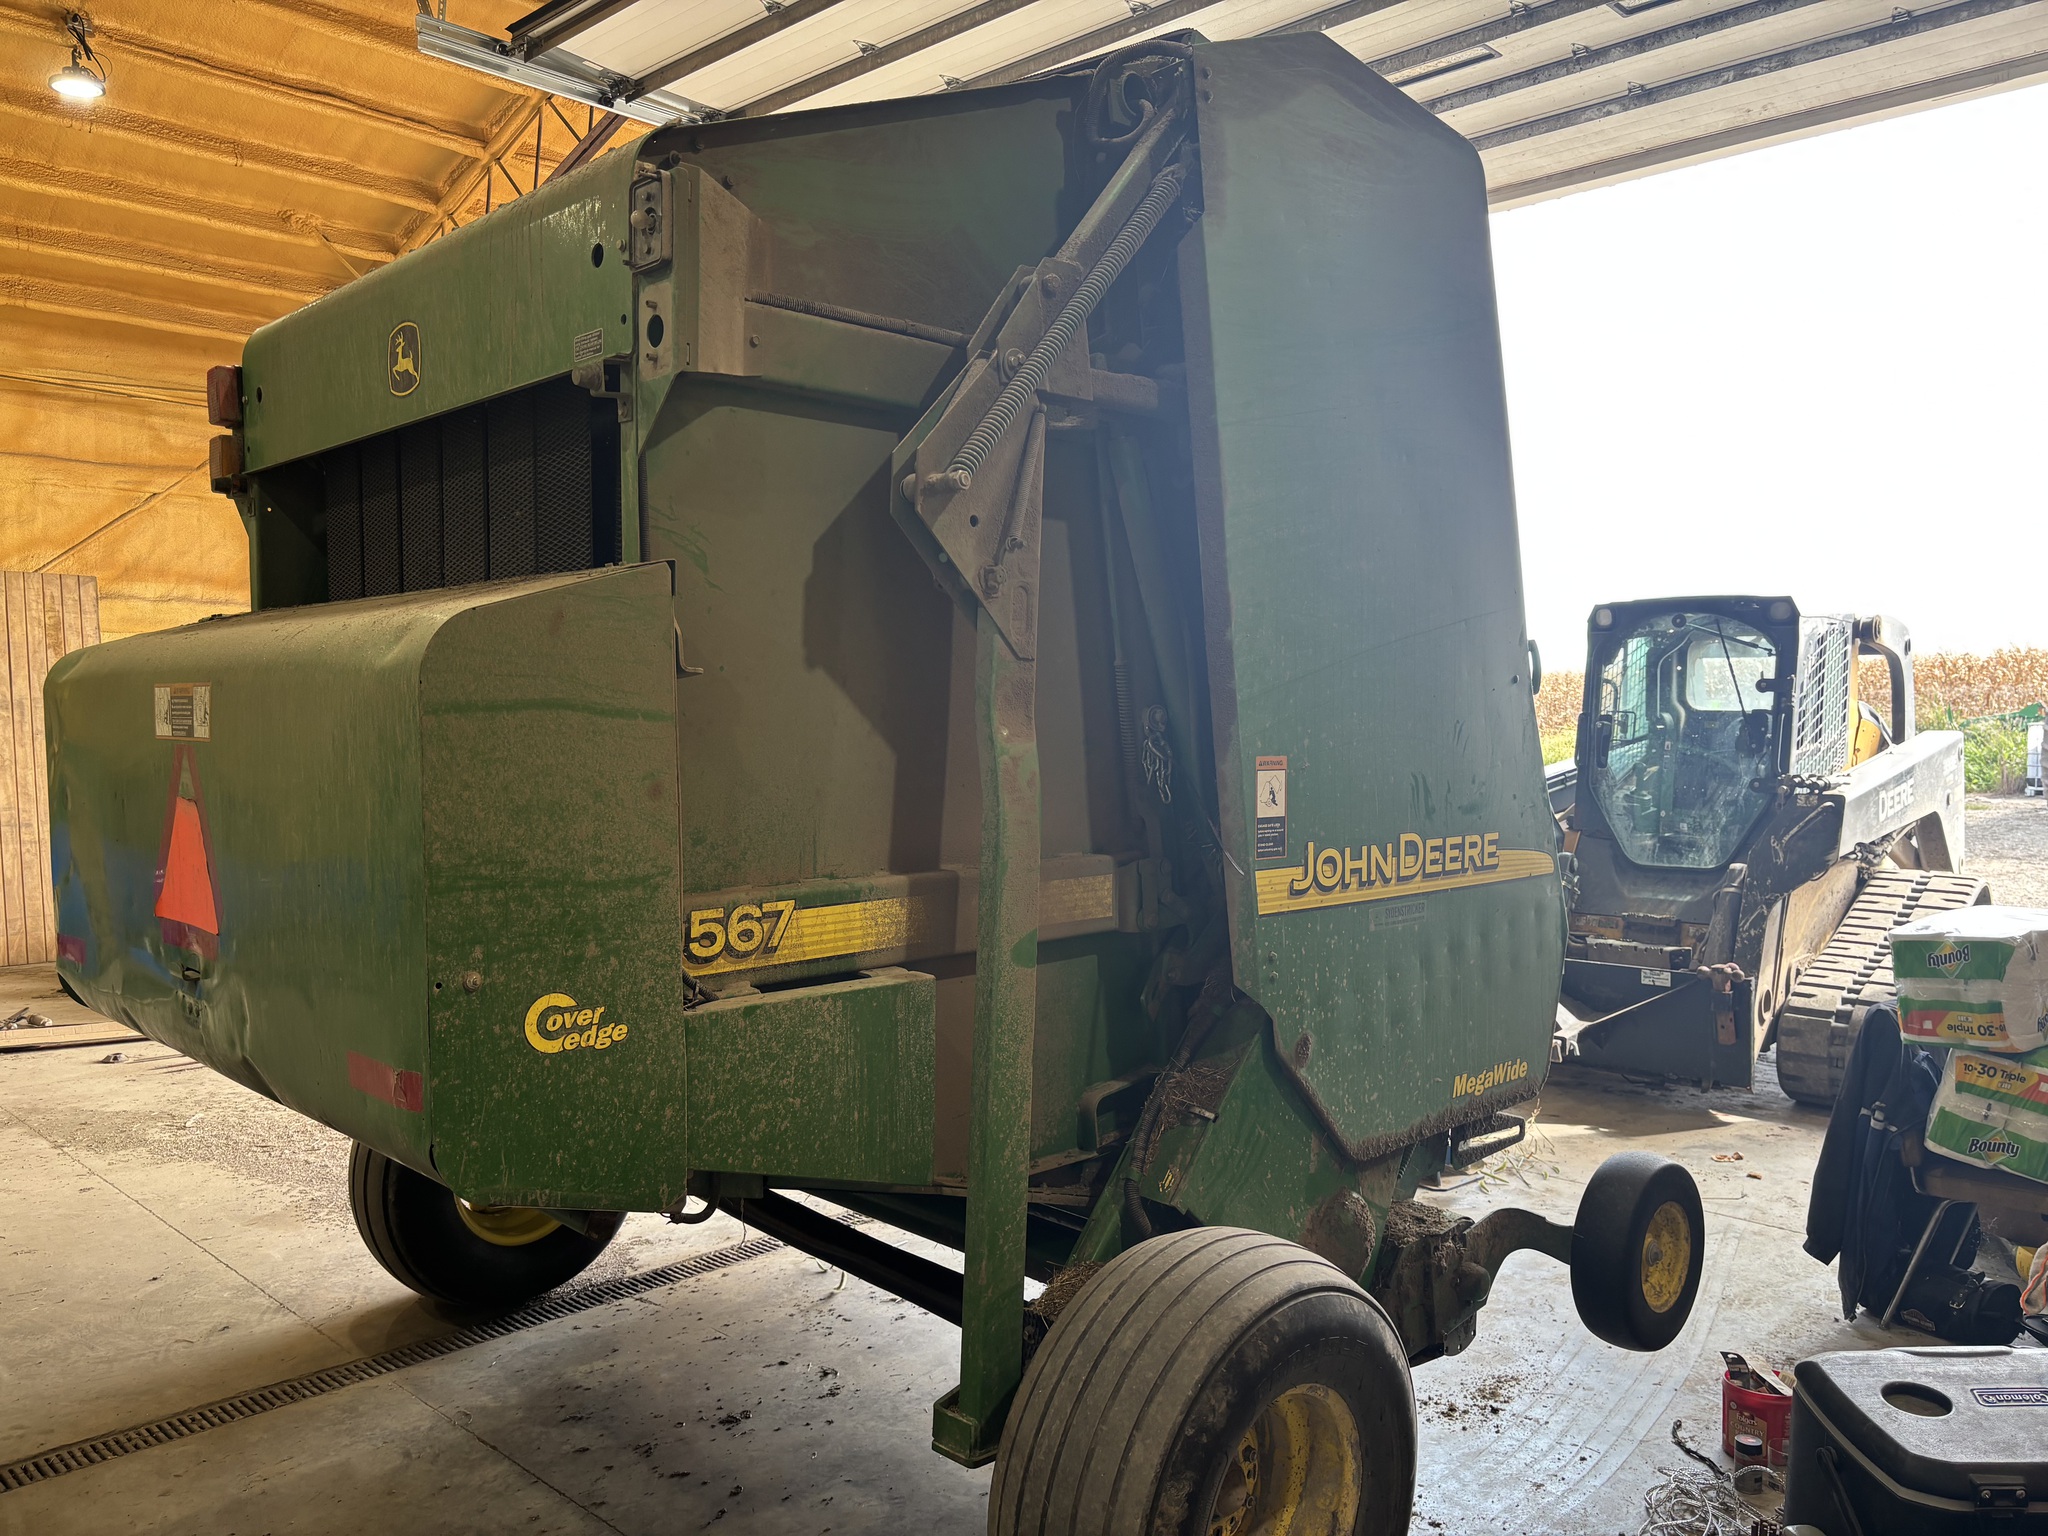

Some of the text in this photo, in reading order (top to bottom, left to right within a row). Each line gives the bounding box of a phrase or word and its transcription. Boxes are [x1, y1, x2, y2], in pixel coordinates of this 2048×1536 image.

[1879, 777, 1915, 823] DEERE
[1292, 831, 1499, 892] JOHN DEERE
[688, 899, 796, 960] 567
[1927, 944, 1971, 968] Bounty
[524, 992, 606, 1054] Cover
[1947, 1023, 1976, 1036] Triple
[562, 1022, 629, 1051] edge
[1452, 1058, 1528, 1099] MegaWide
[2000, 1069, 2027, 1083] Triple
[1968, 1138, 2020, 1158] Bounty
[1995, 1393, 2048, 1403] Coleman
[1729, 1420, 1765, 1437] COUNTRY
